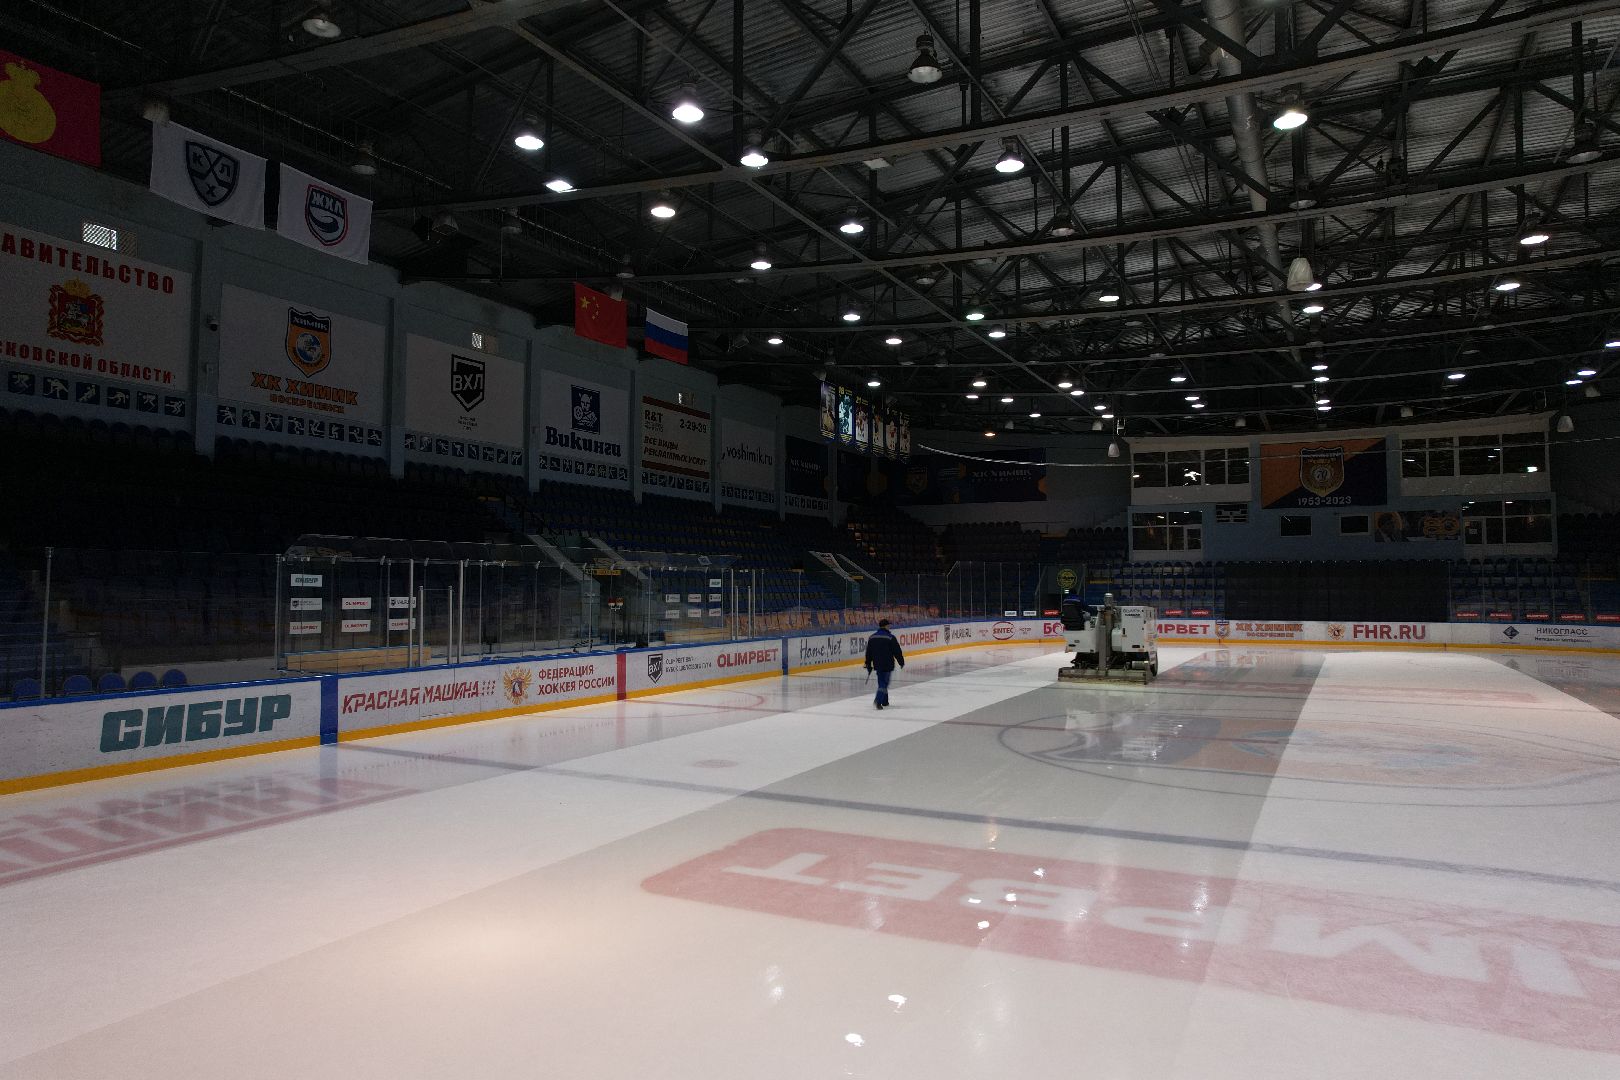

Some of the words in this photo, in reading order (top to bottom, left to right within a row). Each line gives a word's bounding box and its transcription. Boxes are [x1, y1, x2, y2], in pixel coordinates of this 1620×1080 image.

[1, 232, 174, 295] АВИТЕЛЬСТВО
[97, 358, 173, 385] ОБЛАСТИ
[251, 371, 282, 392] ХК
[285, 377, 359, 406] ХИМИК
[453, 373, 484, 391] ВХЛ
[644, 409, 664, 424] R&T
[679, 418, 707, 434] 2-29-39
[545, 425, 622, 458] Викинги
[644, 436, 657, 446] ВСЕ
[1297, 496, 1352, 506] 1953-2023
[992, 627, 1014, 635] SINTEC
[1235, 623, 1252, 632] ХК
[1254, 623, 1304, 632] ХИМИК
[1352, 624, 1426, 640] FHR.RU
[1536, 627, 1588, 636] НИКОГЛАСС
[900, 630, 939, 647] OLIMPBET
[717, 648, 779, 667] OLIMPBET
[537, 664, 595, 685] ФЕДЕРАЦИЯ
[537, 681, 576, 696] ХОККЕЯ
[577, 675, 616, 691] РОССИИ
[341, 686, 420, 714] КРАСНАЯ
[420, 679, 479, 704] МАШИНА
[99, 693, 292, 754] СИБУР
